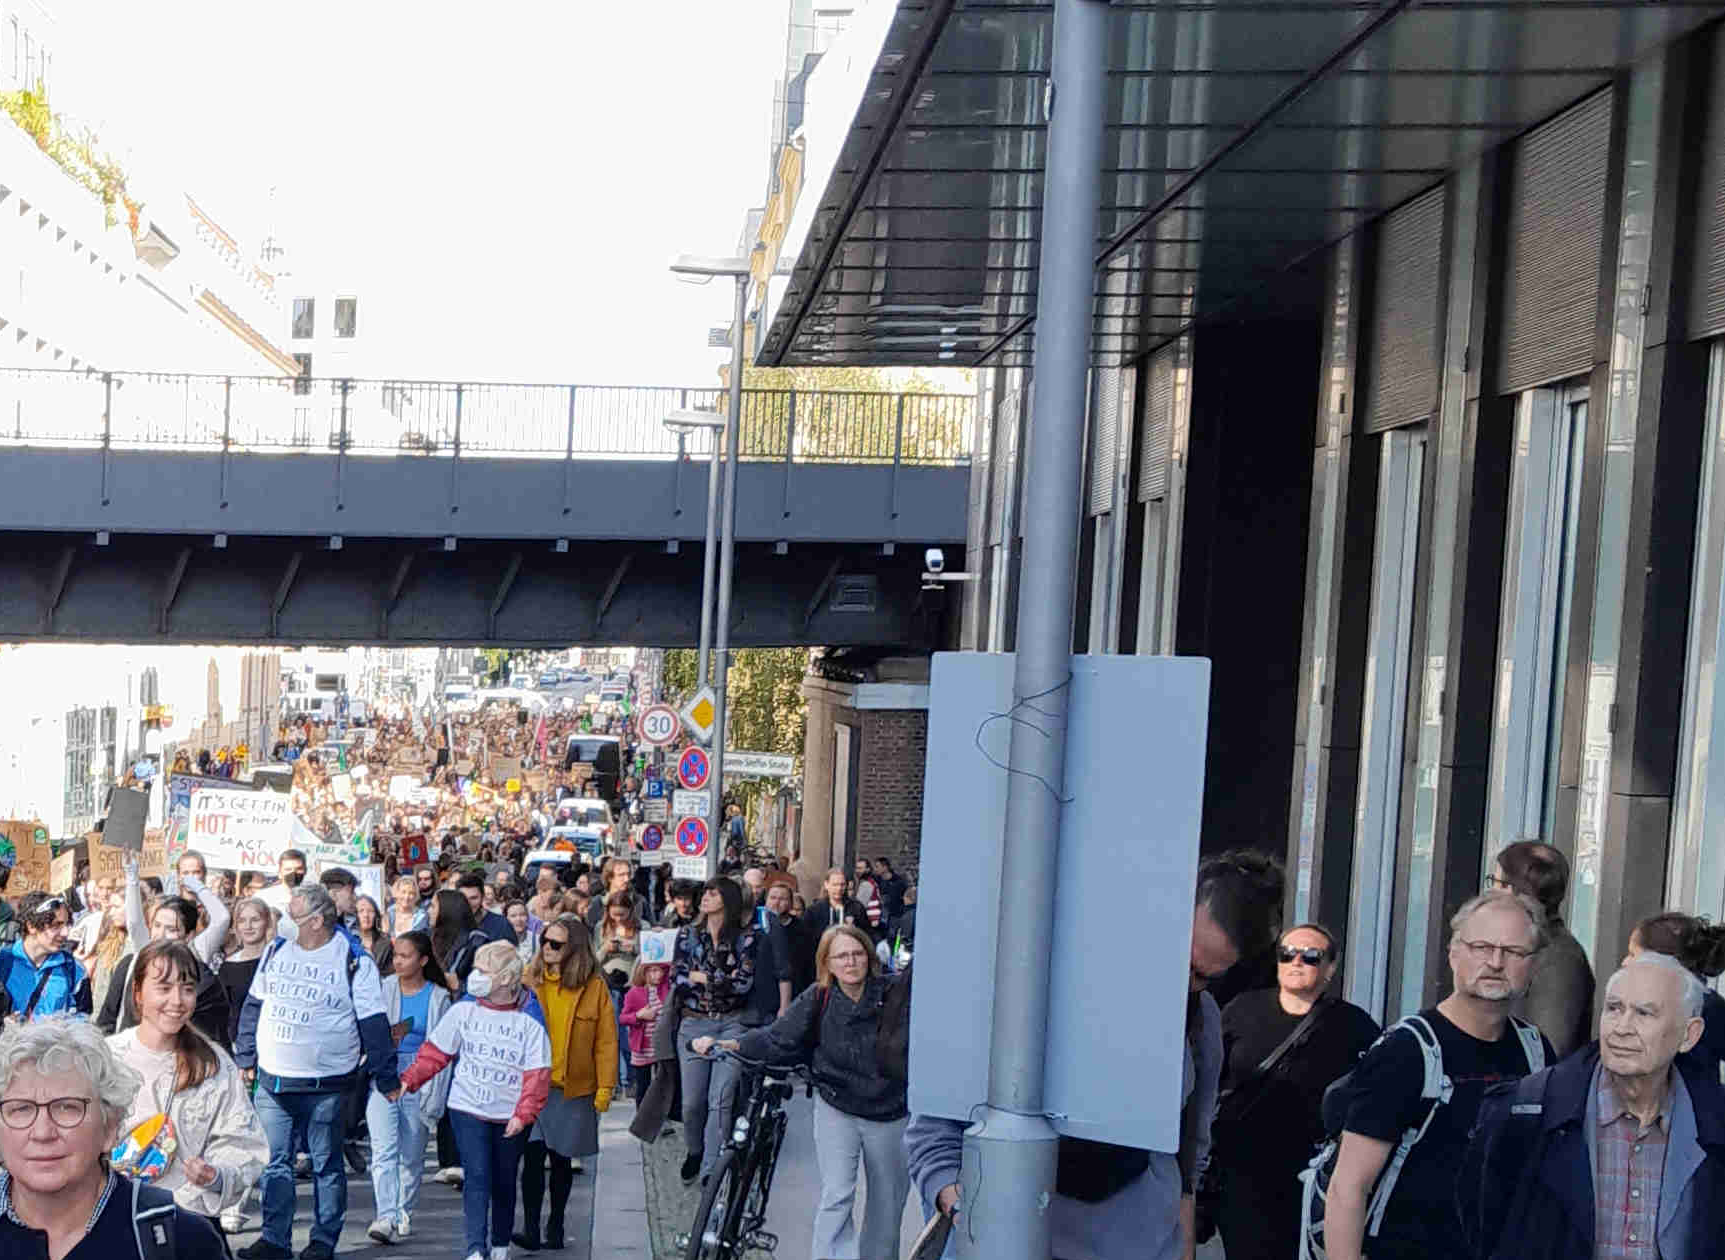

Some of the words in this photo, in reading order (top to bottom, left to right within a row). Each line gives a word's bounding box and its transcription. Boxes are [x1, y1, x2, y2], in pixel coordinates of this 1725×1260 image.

[647, 716, 671, 735] 30
[194, 814, 233, 834] HOT
[235, 839, 266, 850] ACT
